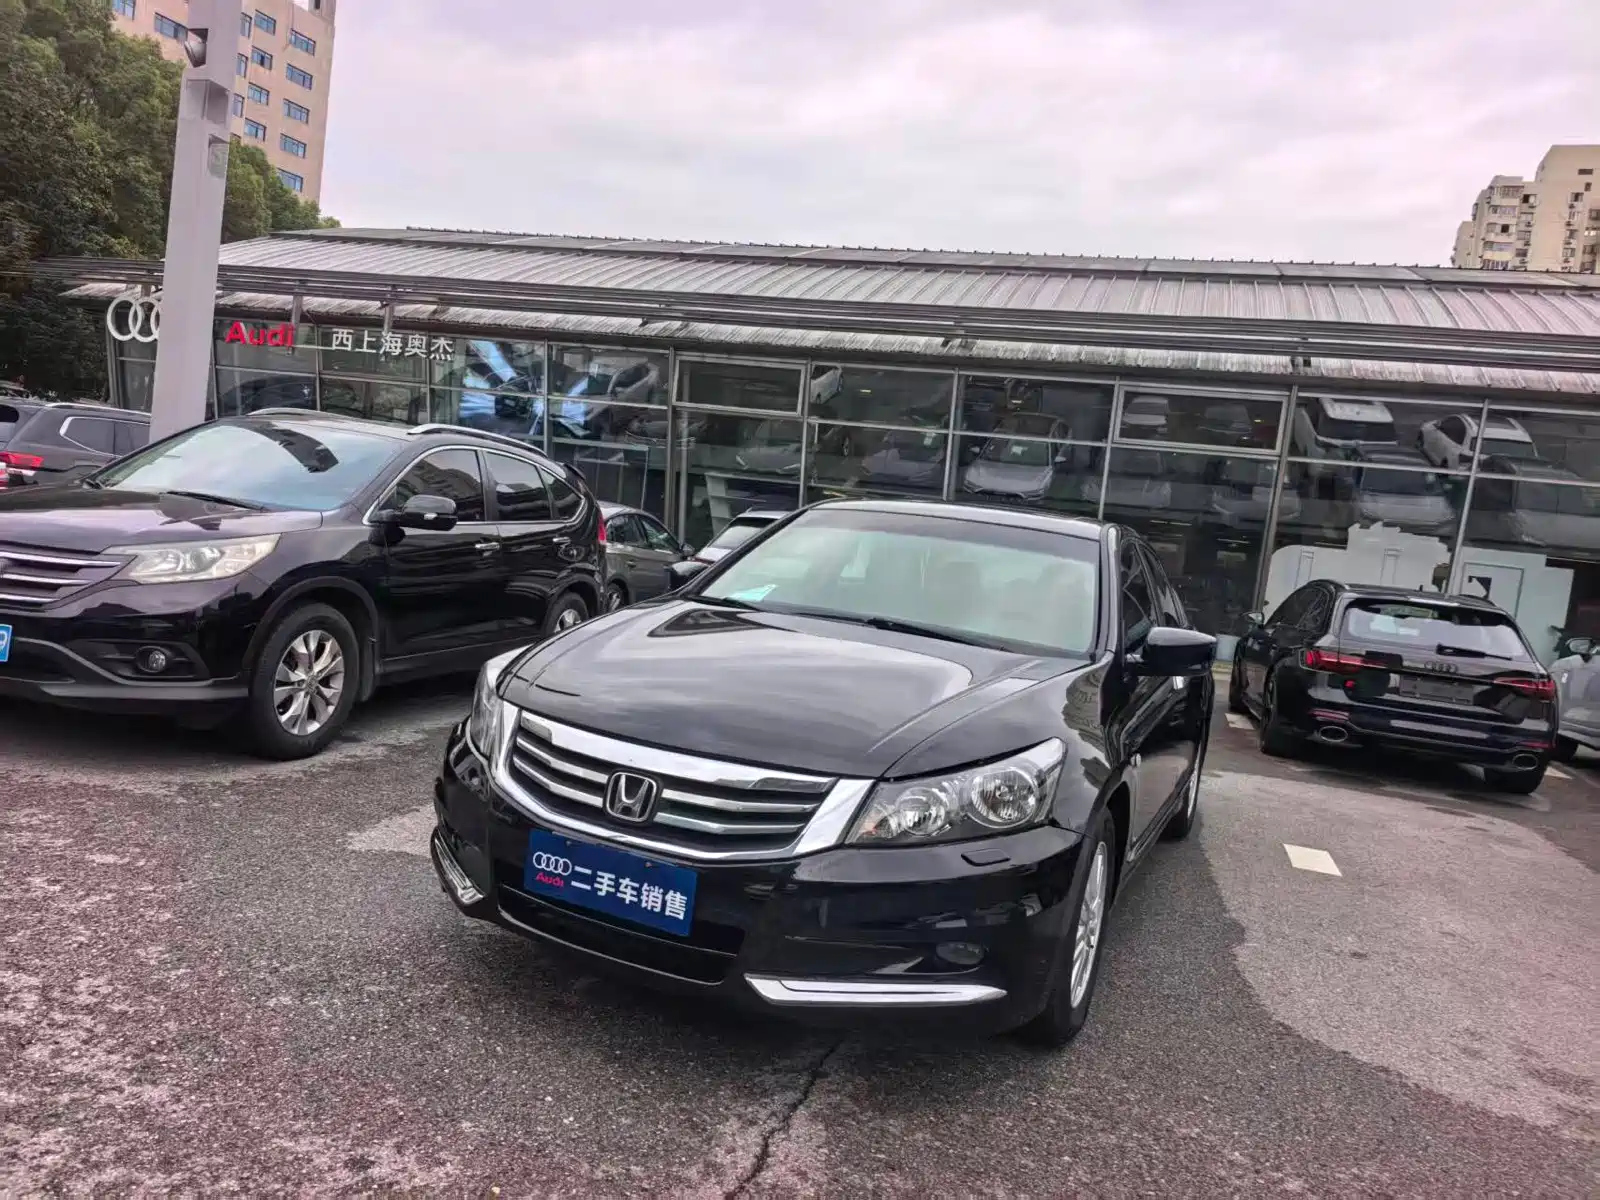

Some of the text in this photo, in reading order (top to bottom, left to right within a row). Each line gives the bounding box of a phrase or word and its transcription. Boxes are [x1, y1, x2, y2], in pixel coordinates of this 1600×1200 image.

[225, 320, 295, 348] Audi
[331, 327, 454, 361] 西上海奥杰
[535, 872, 565, 888] Audi
[571, 865, 688, 921] 二手车销售
